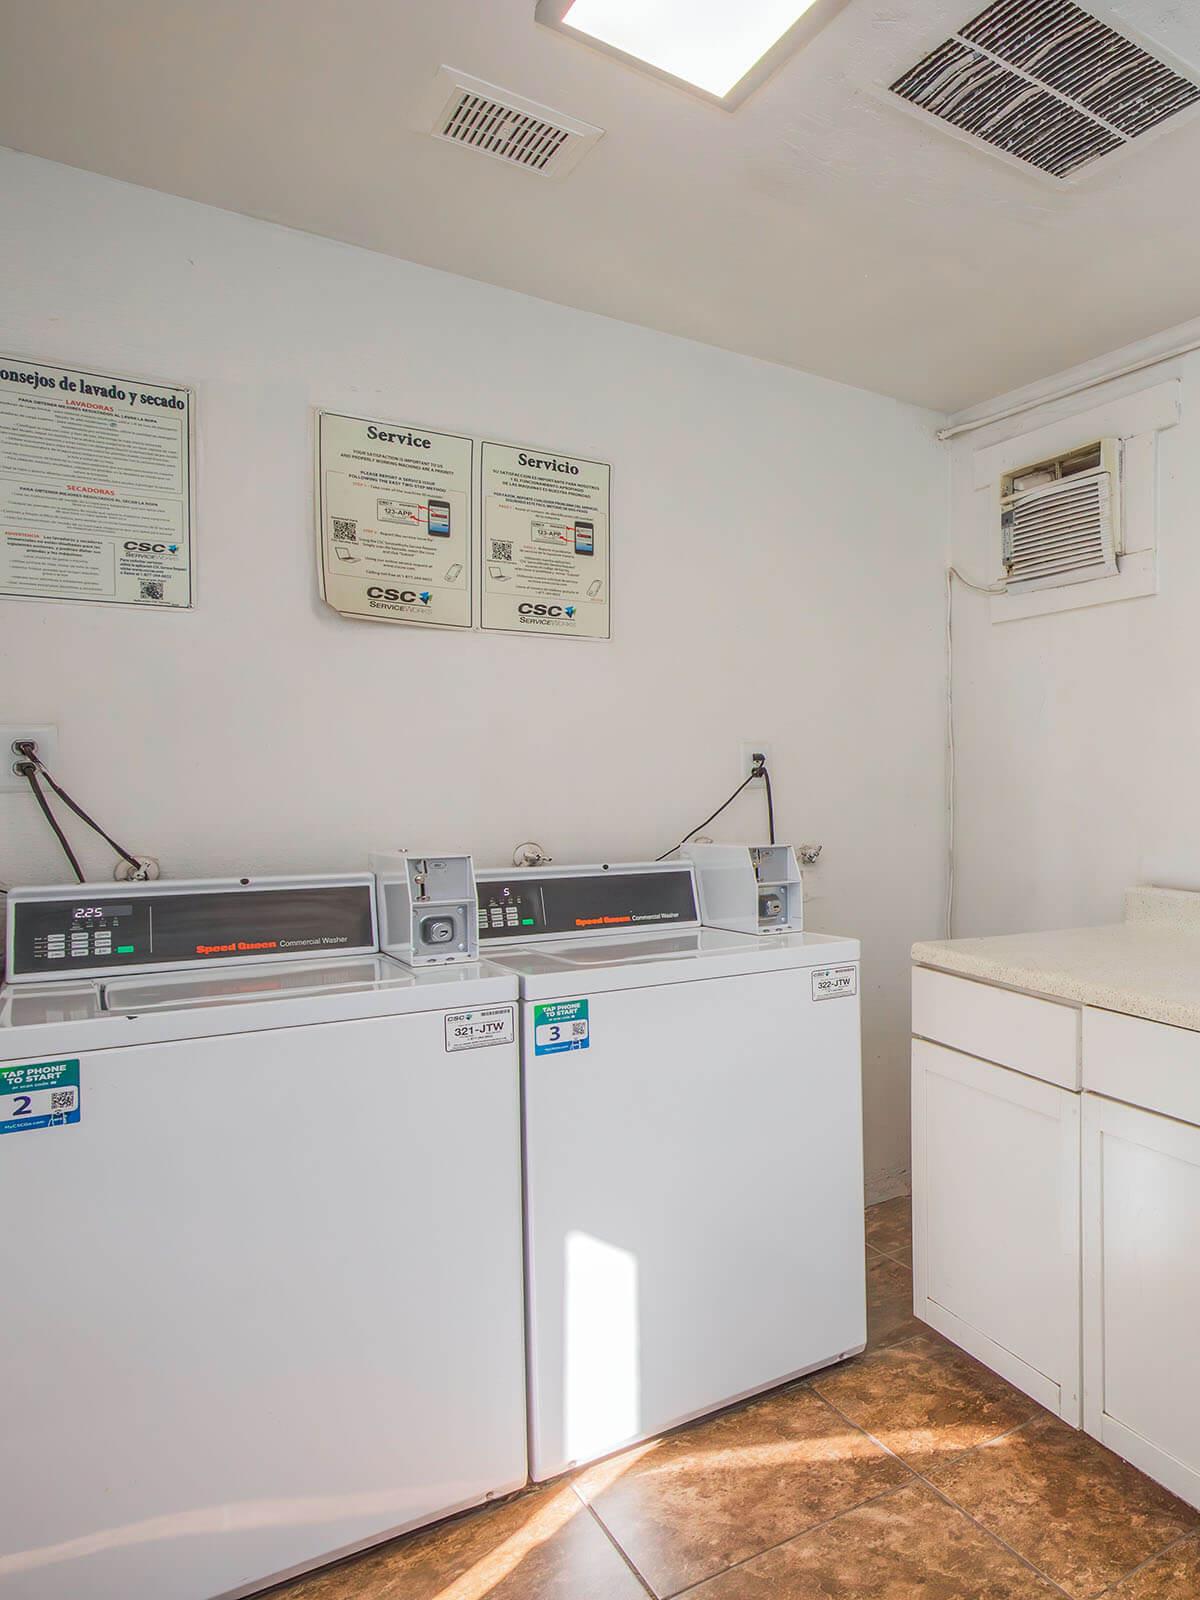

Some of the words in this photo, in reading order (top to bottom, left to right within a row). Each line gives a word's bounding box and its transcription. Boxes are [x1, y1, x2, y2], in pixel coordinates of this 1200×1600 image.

[0, 370, 55, 389] onsejos
[59, 376, 76, 392] de
[80, 379, 126, 401] lavado
[128, 392, 137, 406] y
[140, 394, 185, 410] secado
[65, 400, 114, 412] LAVADORAS
[367, 426, 432, 449] Service
[518, 453, 579, 475] Servicio
[66, 485, 115, 496] SECADORAS
[124, 541, 166, 553] CSC
[367, 587, 416, 602] CSC
[518, 603, 562, 617] CSC
[75, 907, 103, 918] 2.25
[196, 943, 236, 955] Speed
[237, 941, 277, 951] Queen
[280, 939, 321, 947] Commercial
[321, 936, 348, 944] Washer
[818, 978, 850, 989] 322-JTW
[557, 1008, 578, 1016] START
[454, 1022, 504, 1037] 321-JTW
[549, 1026, 560, 1041] 3
[2, 1070, 24, 1078] TAP
[27, 1065, 67, 1075] PHONE
[26, 1072, 62, 1082] START
[13, 1096, 32, 1116] 2
